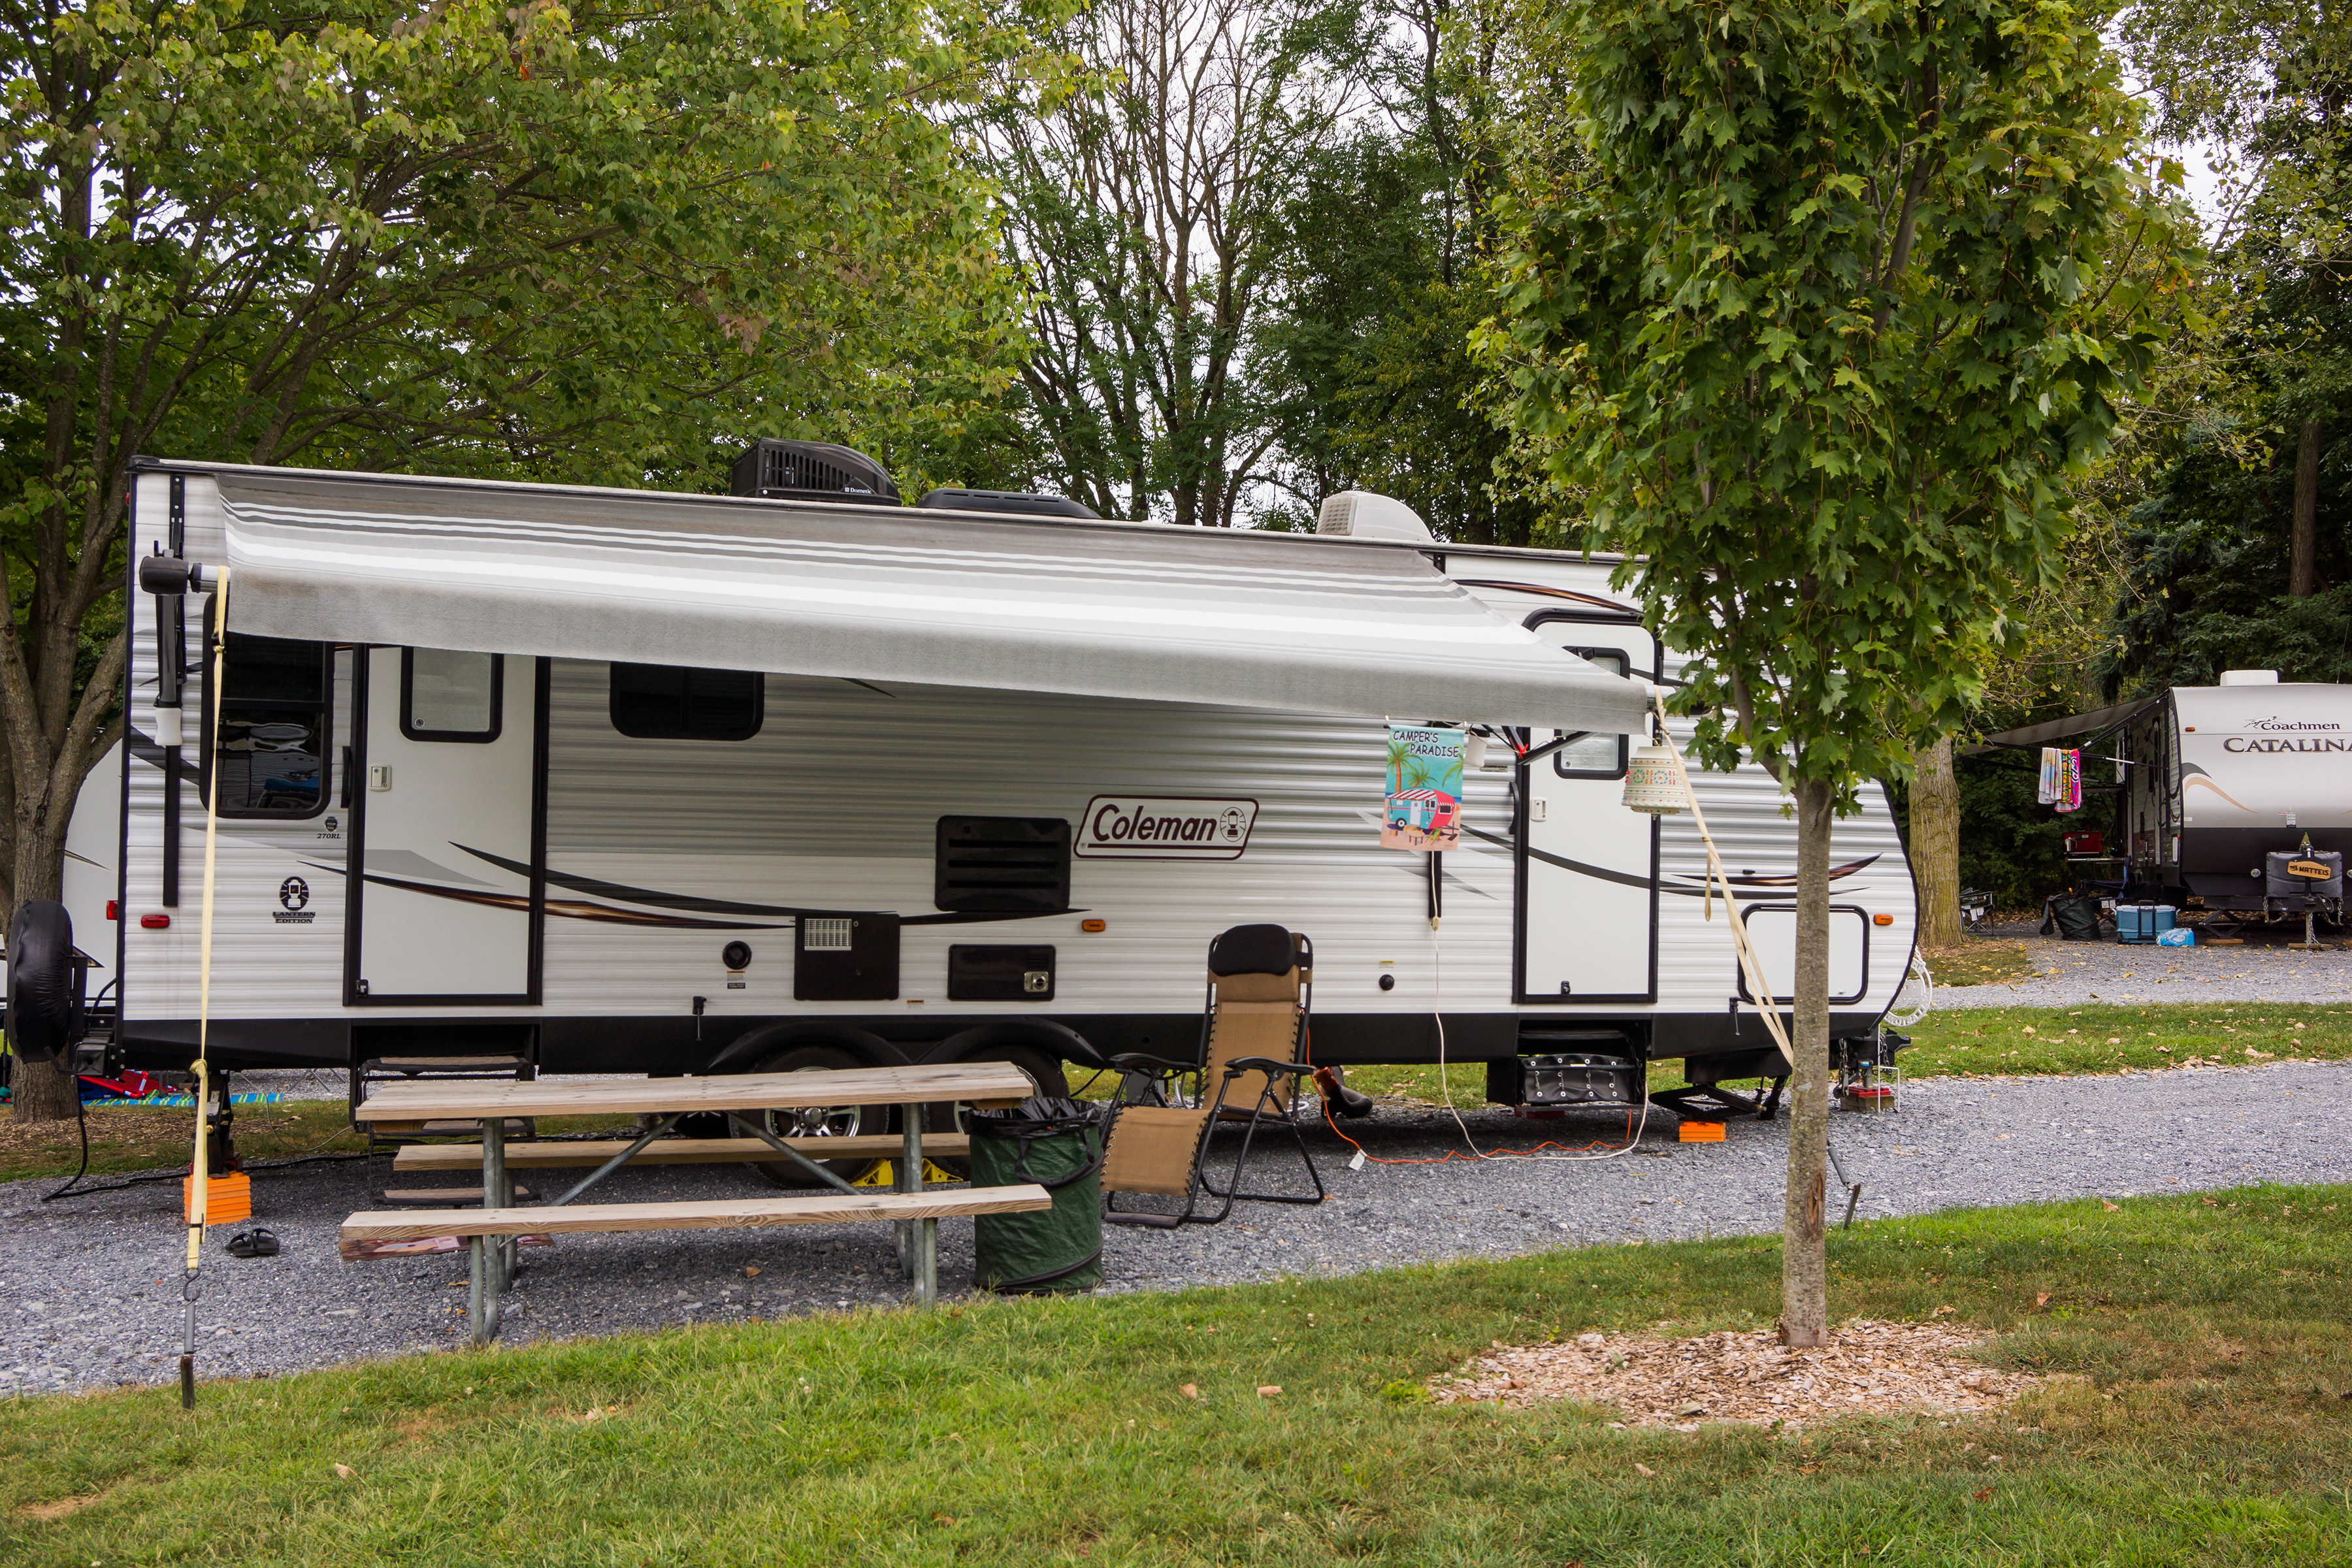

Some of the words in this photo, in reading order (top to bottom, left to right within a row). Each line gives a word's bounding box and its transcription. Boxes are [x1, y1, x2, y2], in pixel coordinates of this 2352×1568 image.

[2261, 722, 2340, 730] Coachmen
[1393, 730, 1439, 743] CAMPER'S
[1410, 743, 1460, 757] PARADISE
[1092, 804, 1217, 841] Coleman
